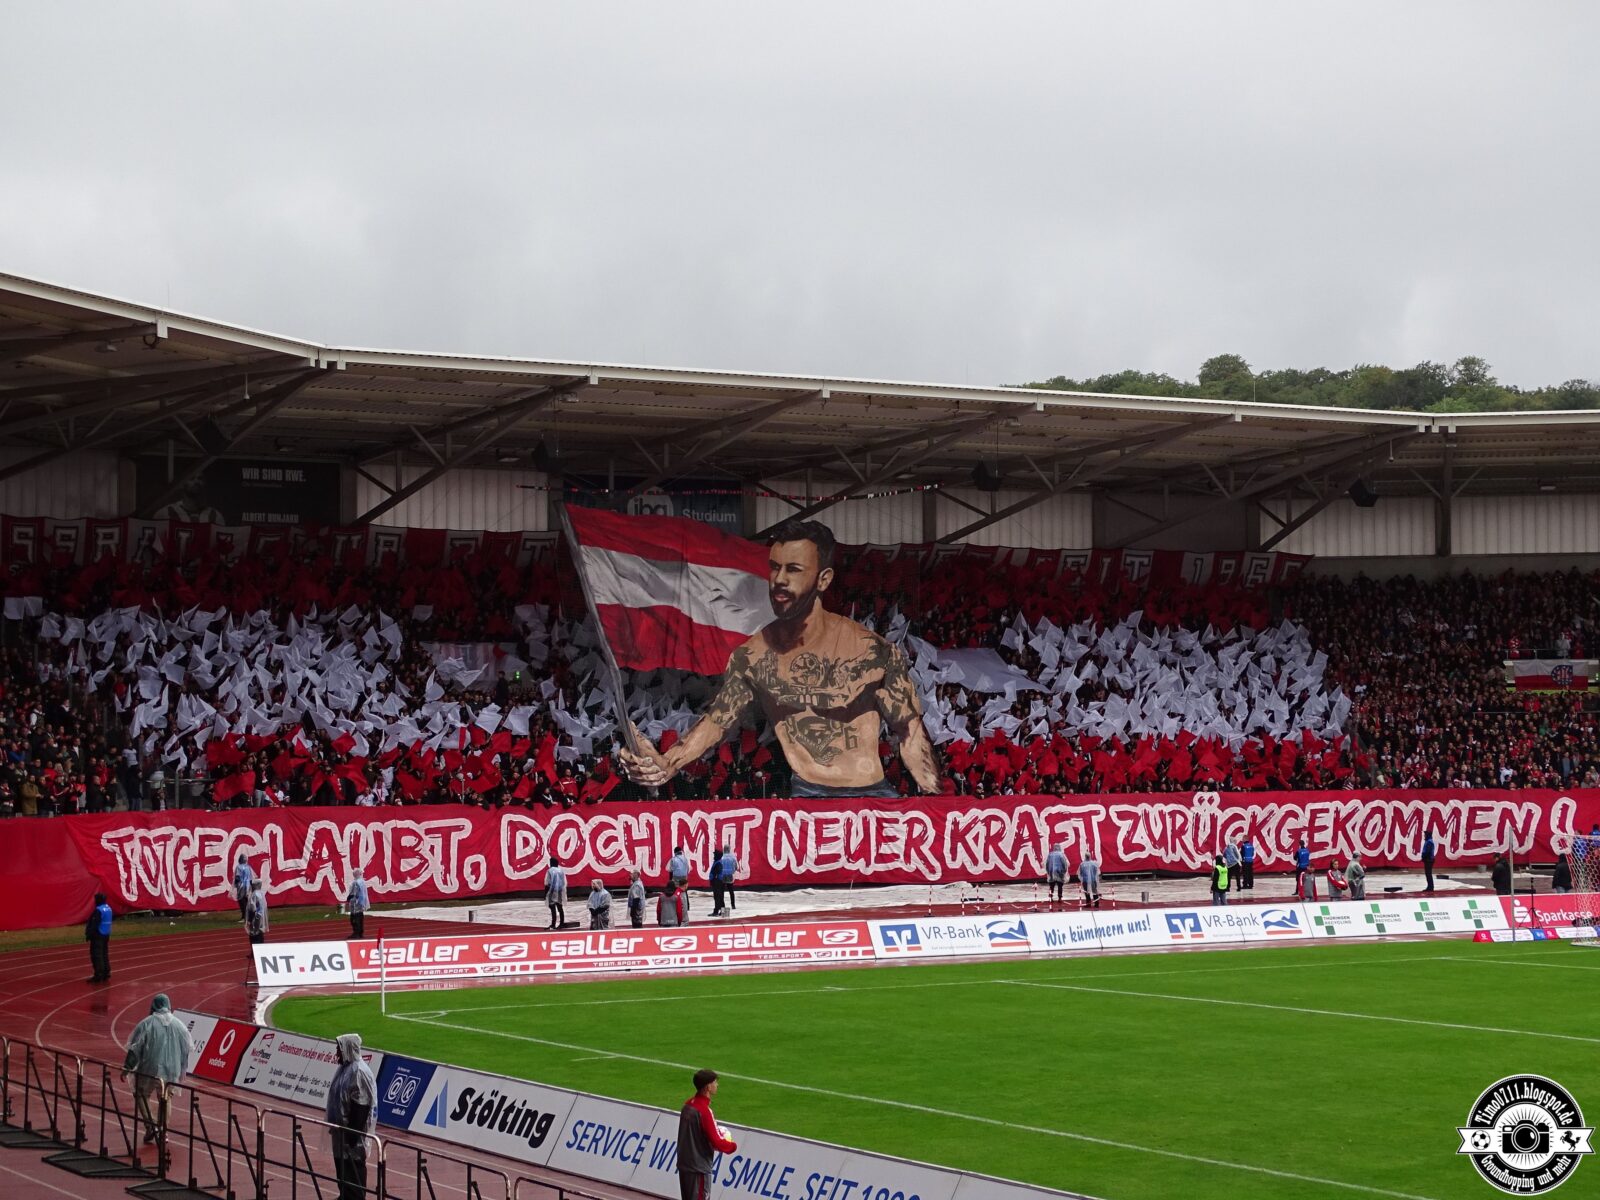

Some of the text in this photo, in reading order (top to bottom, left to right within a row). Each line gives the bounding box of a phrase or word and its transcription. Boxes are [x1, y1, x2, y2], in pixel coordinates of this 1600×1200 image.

[242, 467, 307, 482] WIR SIND RWE.
[682, 508, 737, 523] Studium
[501, 813, 661, 880] DOCH
[671, 808, 762, 881] MIT
[767, 809, 942, 880] NEUER
[944, 804, 1106, 877] KRAFT
[1203, 912, 1259, 929] VR-Bank
[1535, 908, 1593, 925] Sparkasse
[921, 920, 984, 941] VR-Bank
[1044, 913, 1152, 947] Wir kümmern uns!
[278, 1041, 302, 1056] Gemeinsam
[301, 1047, 318, 1060] rocken
[450, 1087, 555, 1149] Stölting
[566, 1119, 651, 1164] SERVICE
